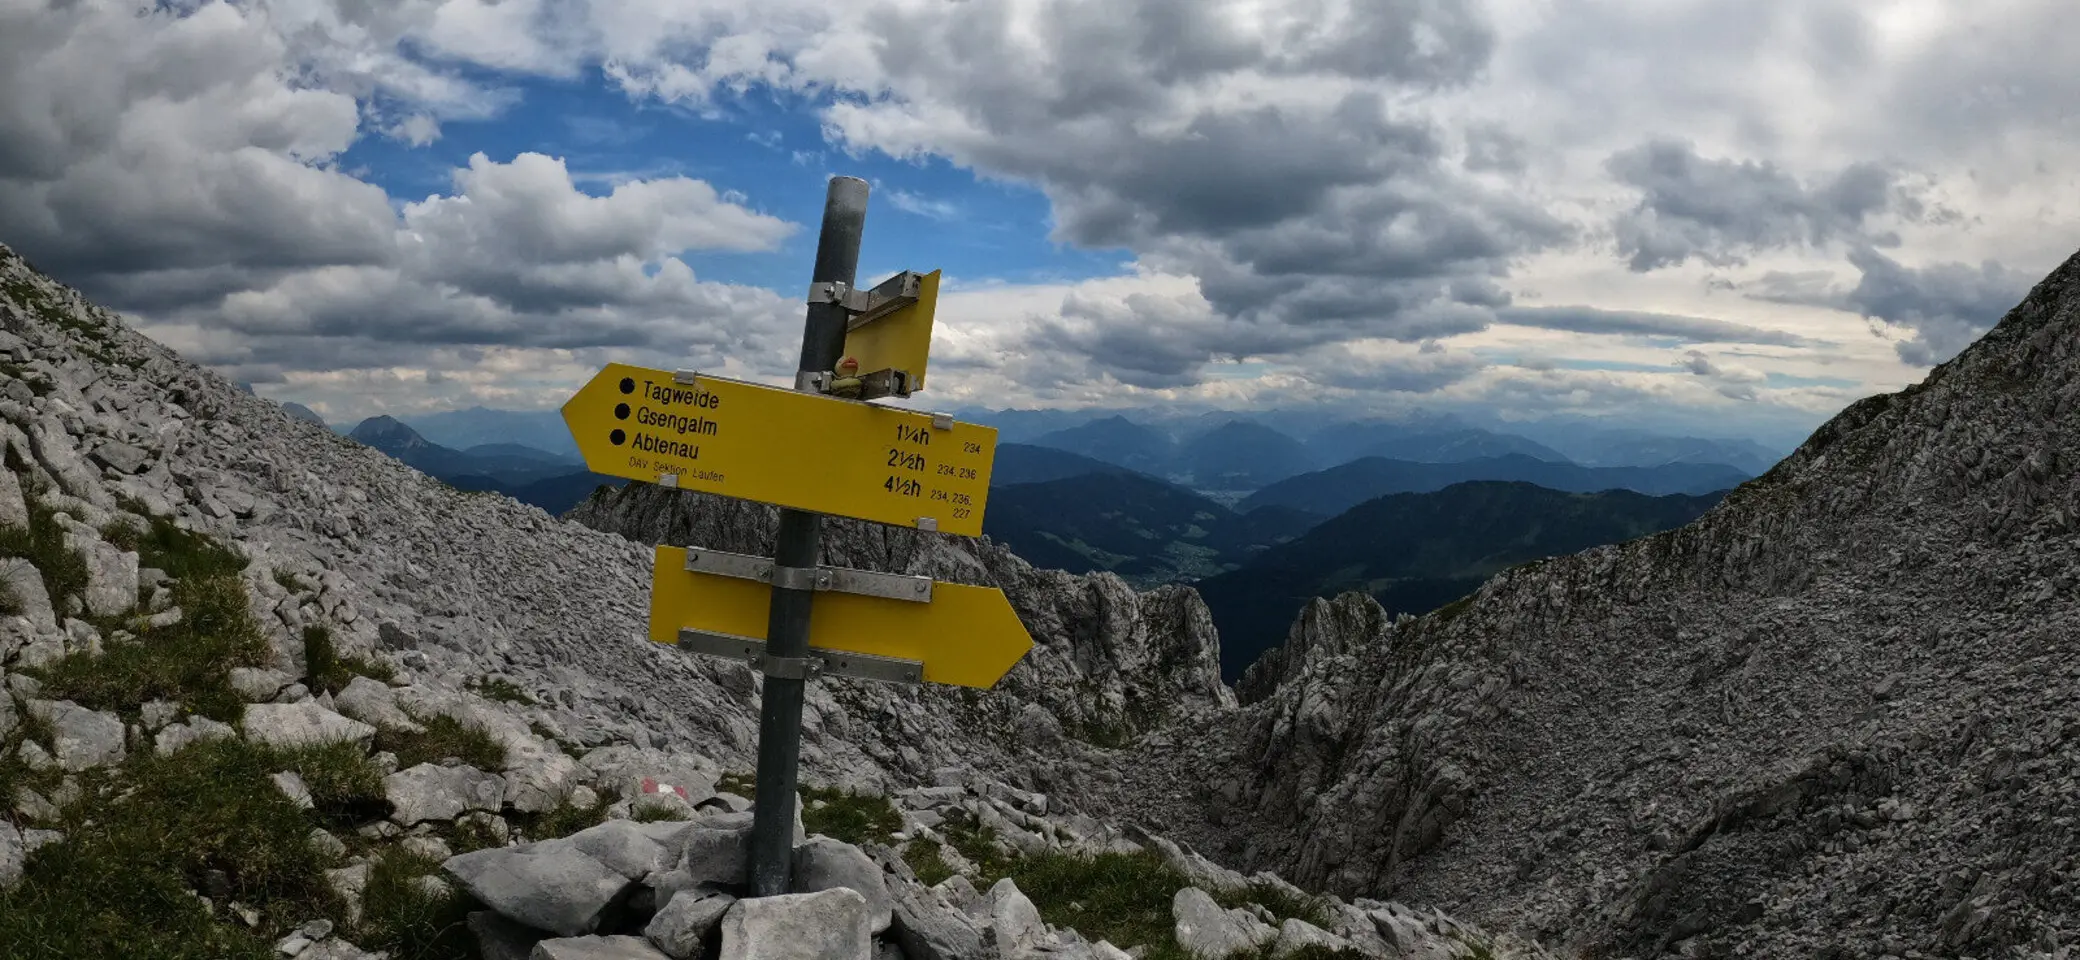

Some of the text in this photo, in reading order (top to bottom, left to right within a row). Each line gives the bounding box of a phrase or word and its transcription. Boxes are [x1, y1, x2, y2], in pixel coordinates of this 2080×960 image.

[644, 380, 719, 409] Tagweide
[637, 406, 717, 436] Gsengalm
[632, 432, 699, 459] Abtenau
[963, 442, 981, 454] 234
[628, 456, 648, 469] DAV
[653, 461, 687, 476] Sektion
[959, 467, 977, 480] 236
[952, 507, 971, 519] 227
